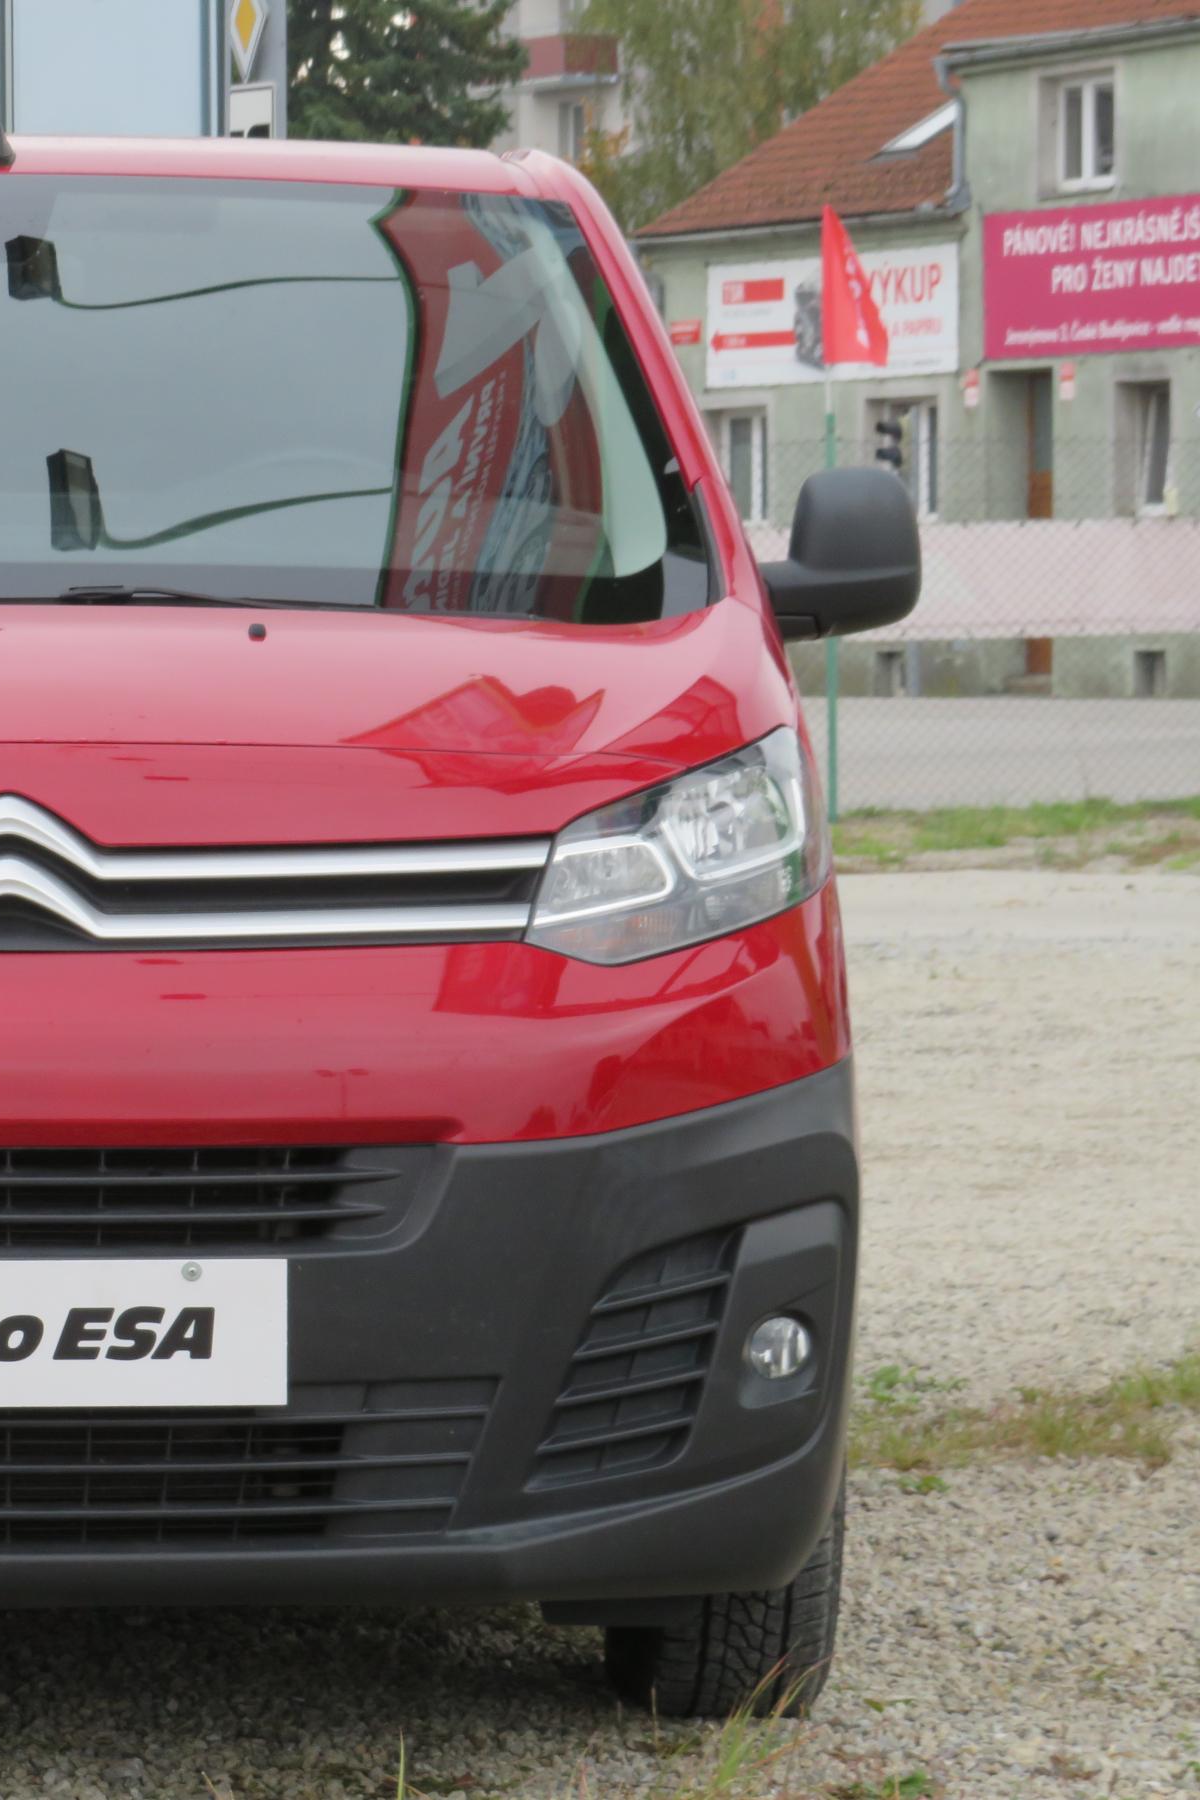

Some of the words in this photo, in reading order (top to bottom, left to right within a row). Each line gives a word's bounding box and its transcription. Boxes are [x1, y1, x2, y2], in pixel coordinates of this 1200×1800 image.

[1050, 262, 1089, 294] PRO
[1091, 256, 1138, 292] ŽENY
[52, 1306, 216, 1361] ESA
